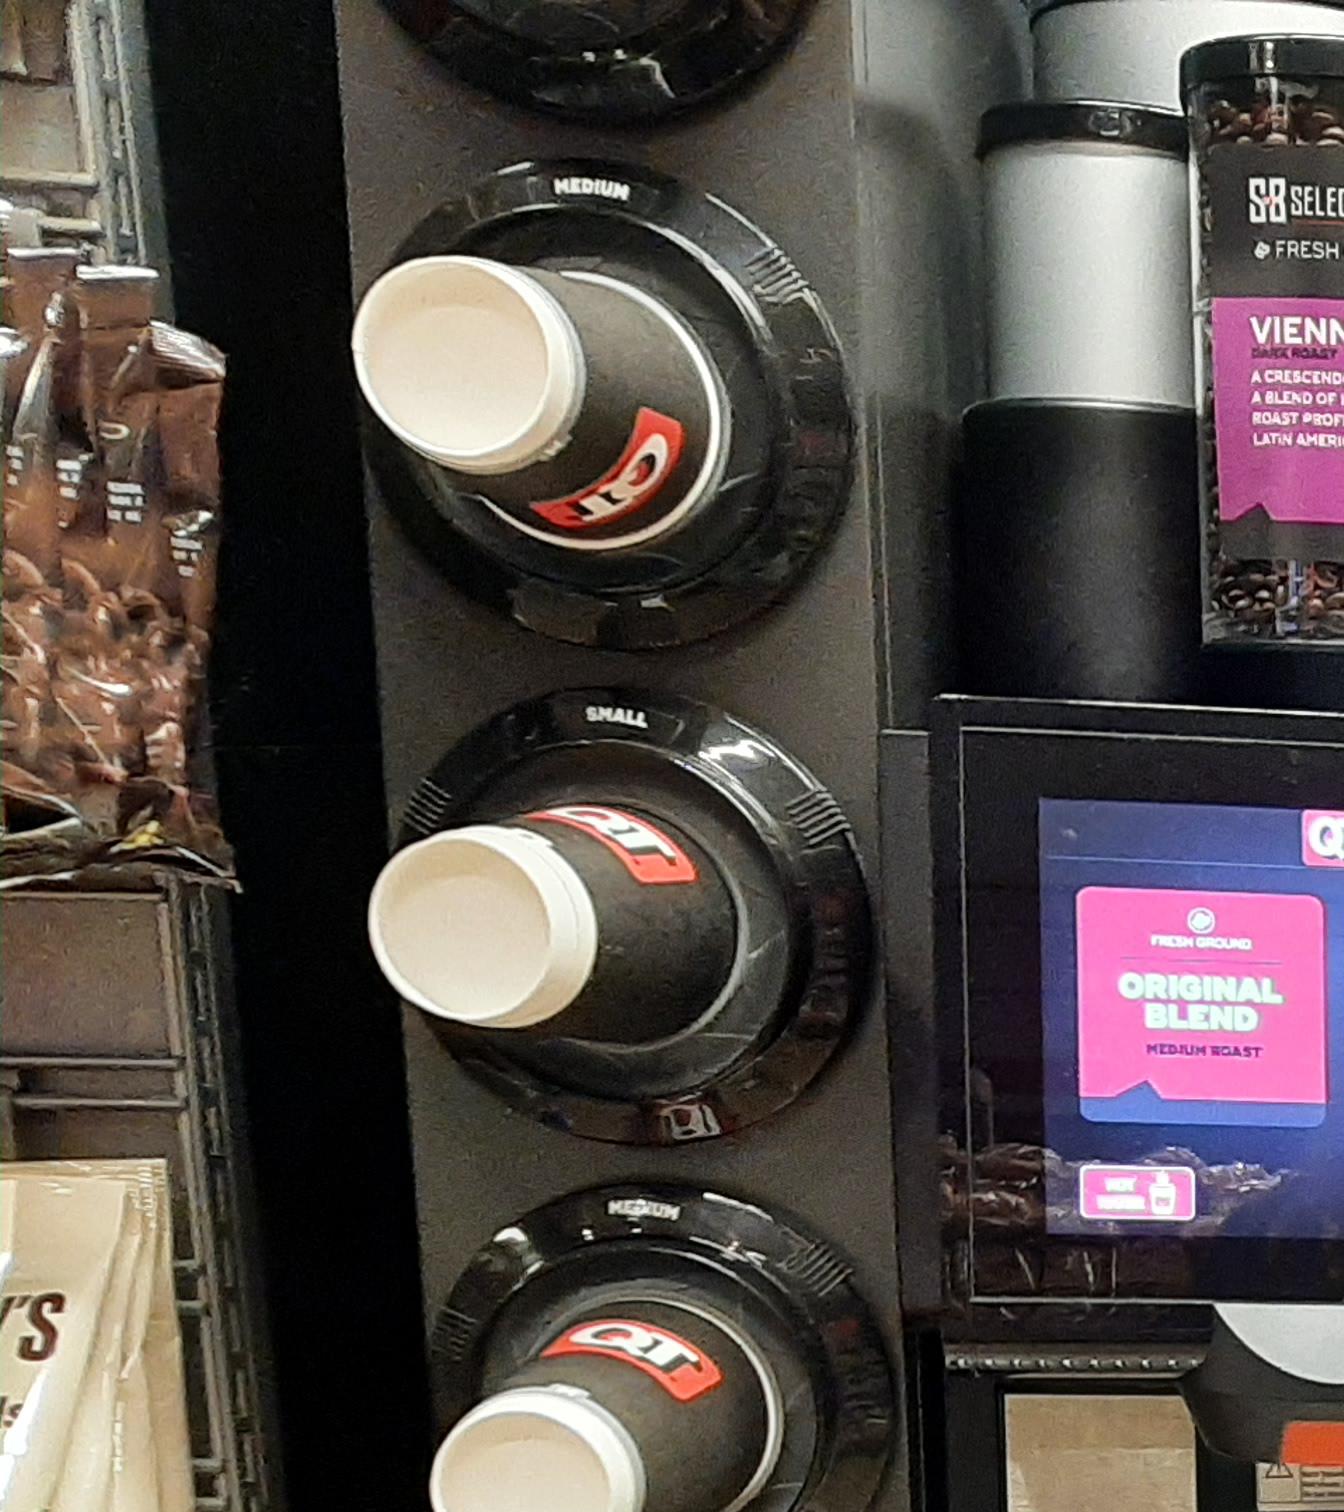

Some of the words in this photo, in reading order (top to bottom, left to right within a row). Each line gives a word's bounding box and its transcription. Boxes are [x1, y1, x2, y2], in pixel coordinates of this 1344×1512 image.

[553, 177, 630, 200] MEDIUM
[1275, 240, 1339, 260] FRESH
[1251, 370, 1261, 384] A
[1251, 391, 1262, 404] A
[1265, 391, 1312, 405] BLEND
[1316, 392, 1337, 405] OF
[1252, 412, 1298, 425] ROAST
[1253, 432, 1292, 446] LATIN
[586, 706, 648, 729] SMALL
[1151, 936, 1192, 950] FRESH
[1196, 936, 1252, 951] GROUND
[1118, 973, 1284, 1004] ORIGINAL
[1144, 1003, 1258, 1032] BLEND
[1146, 1043, 1207, 1057] MEDIUM
[1211, 1044, 1263, 1058] ROAST
[608, 1200, 681, 1221] MEDIUM
